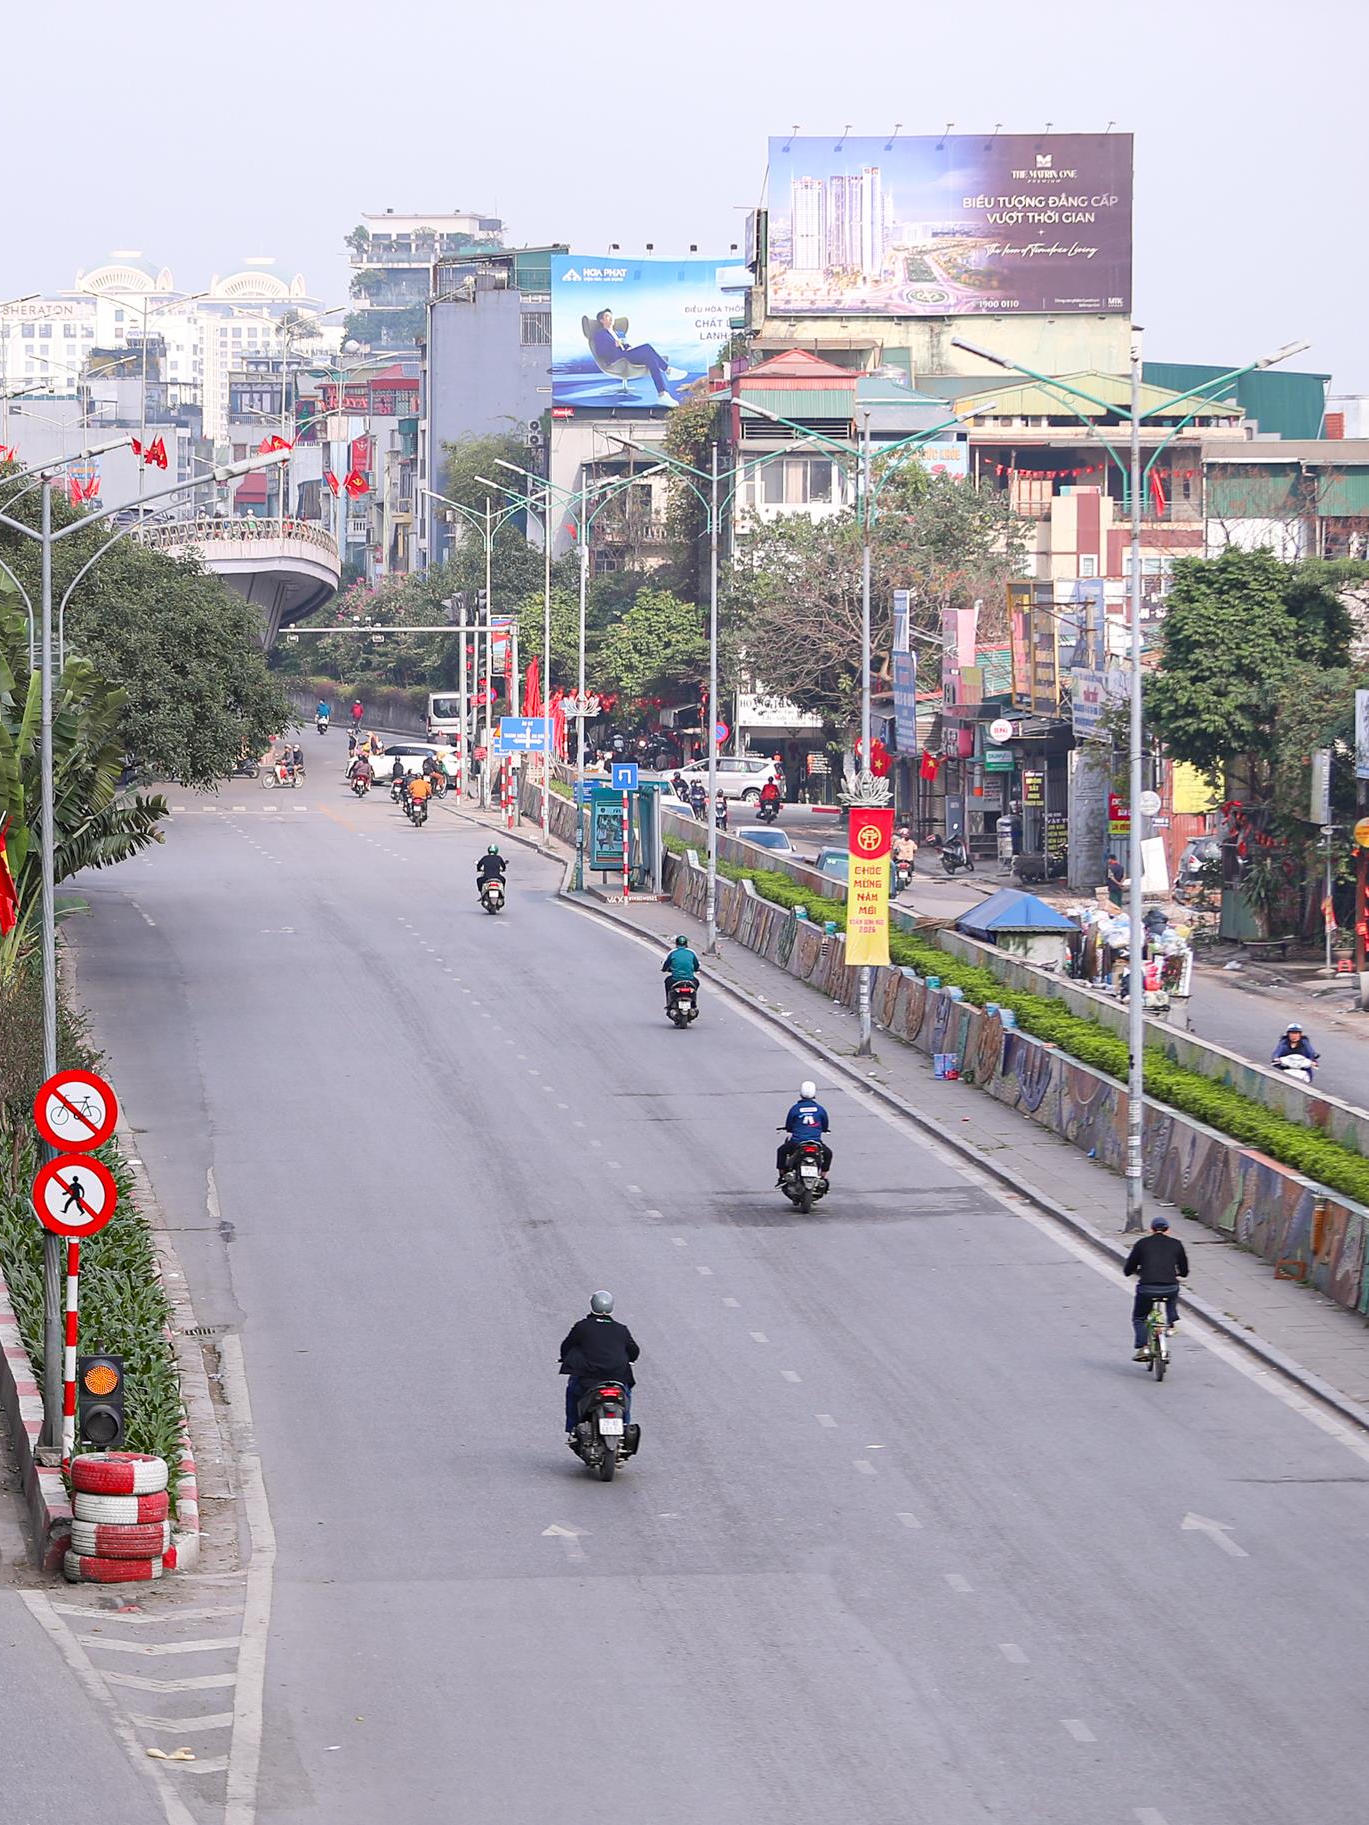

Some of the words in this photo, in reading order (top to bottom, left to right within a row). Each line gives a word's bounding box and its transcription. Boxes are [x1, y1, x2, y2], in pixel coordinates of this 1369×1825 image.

[997, 194, 1046, 210] TƯỢNG
[1090, 192, 1119, 207] CẤP
[986, 211, 1024, 227] VƯỢT
[1026, 209, 1059, 224] THỜI
[1061, 212, 1096, 224] GIAN
[2, 305, 73, 315] SHERATON
[979, 300, 998, 309] 1900
